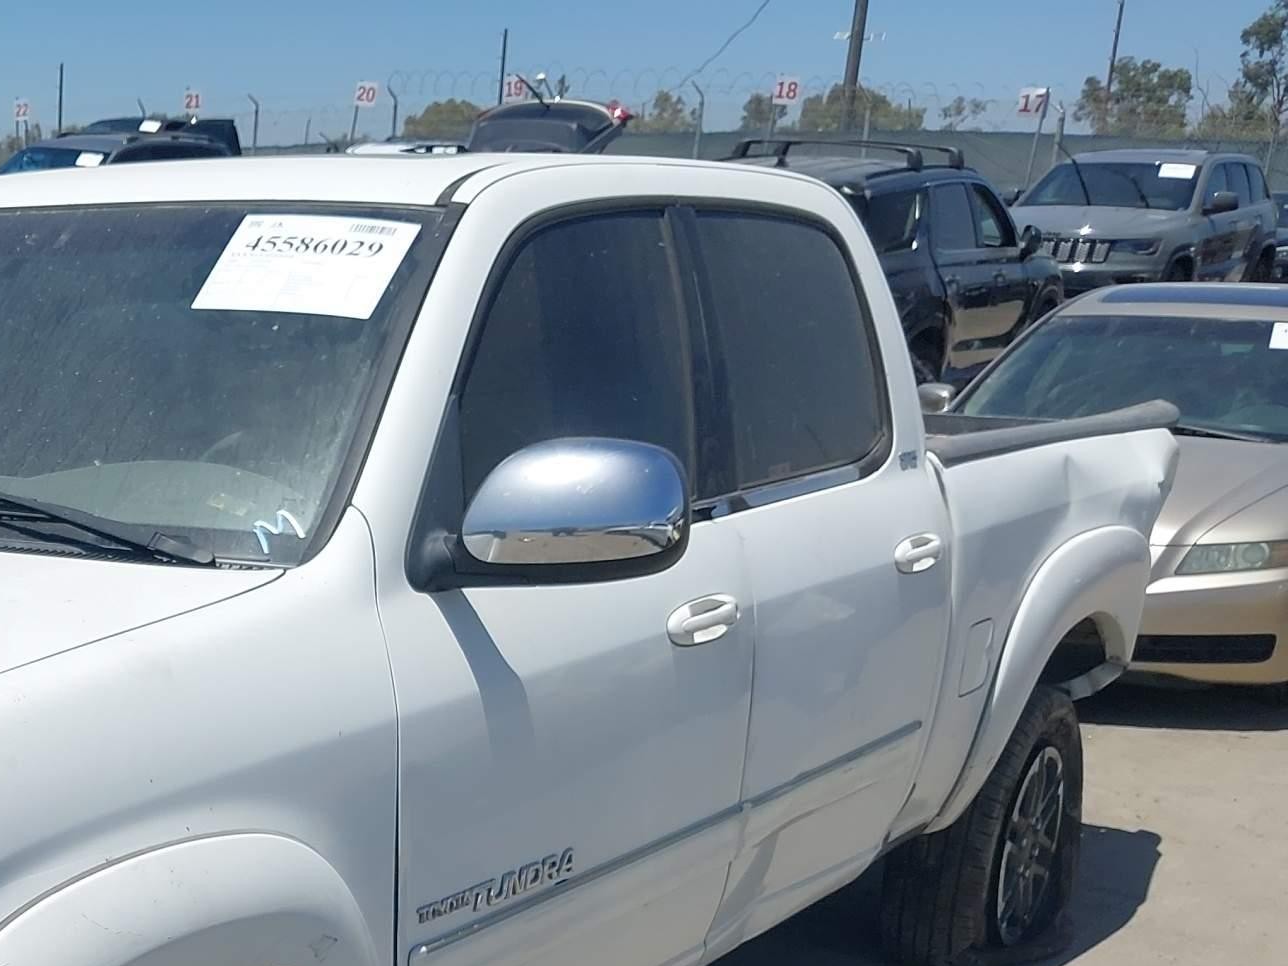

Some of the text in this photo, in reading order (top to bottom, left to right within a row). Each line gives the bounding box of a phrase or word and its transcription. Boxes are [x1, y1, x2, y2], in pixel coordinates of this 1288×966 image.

[356, 85, 376, 103] 20
[506, 78, 522, 97] 19
[775, 81, 798, 100] 18
[15, 103, 29, 117] 22
[184, 93, 200, 109] 21
[1018, 93, 1048, 113] 17
[245, 235, 384, 258] 45586029
[464, 847, 574, 912] TUNDRA
